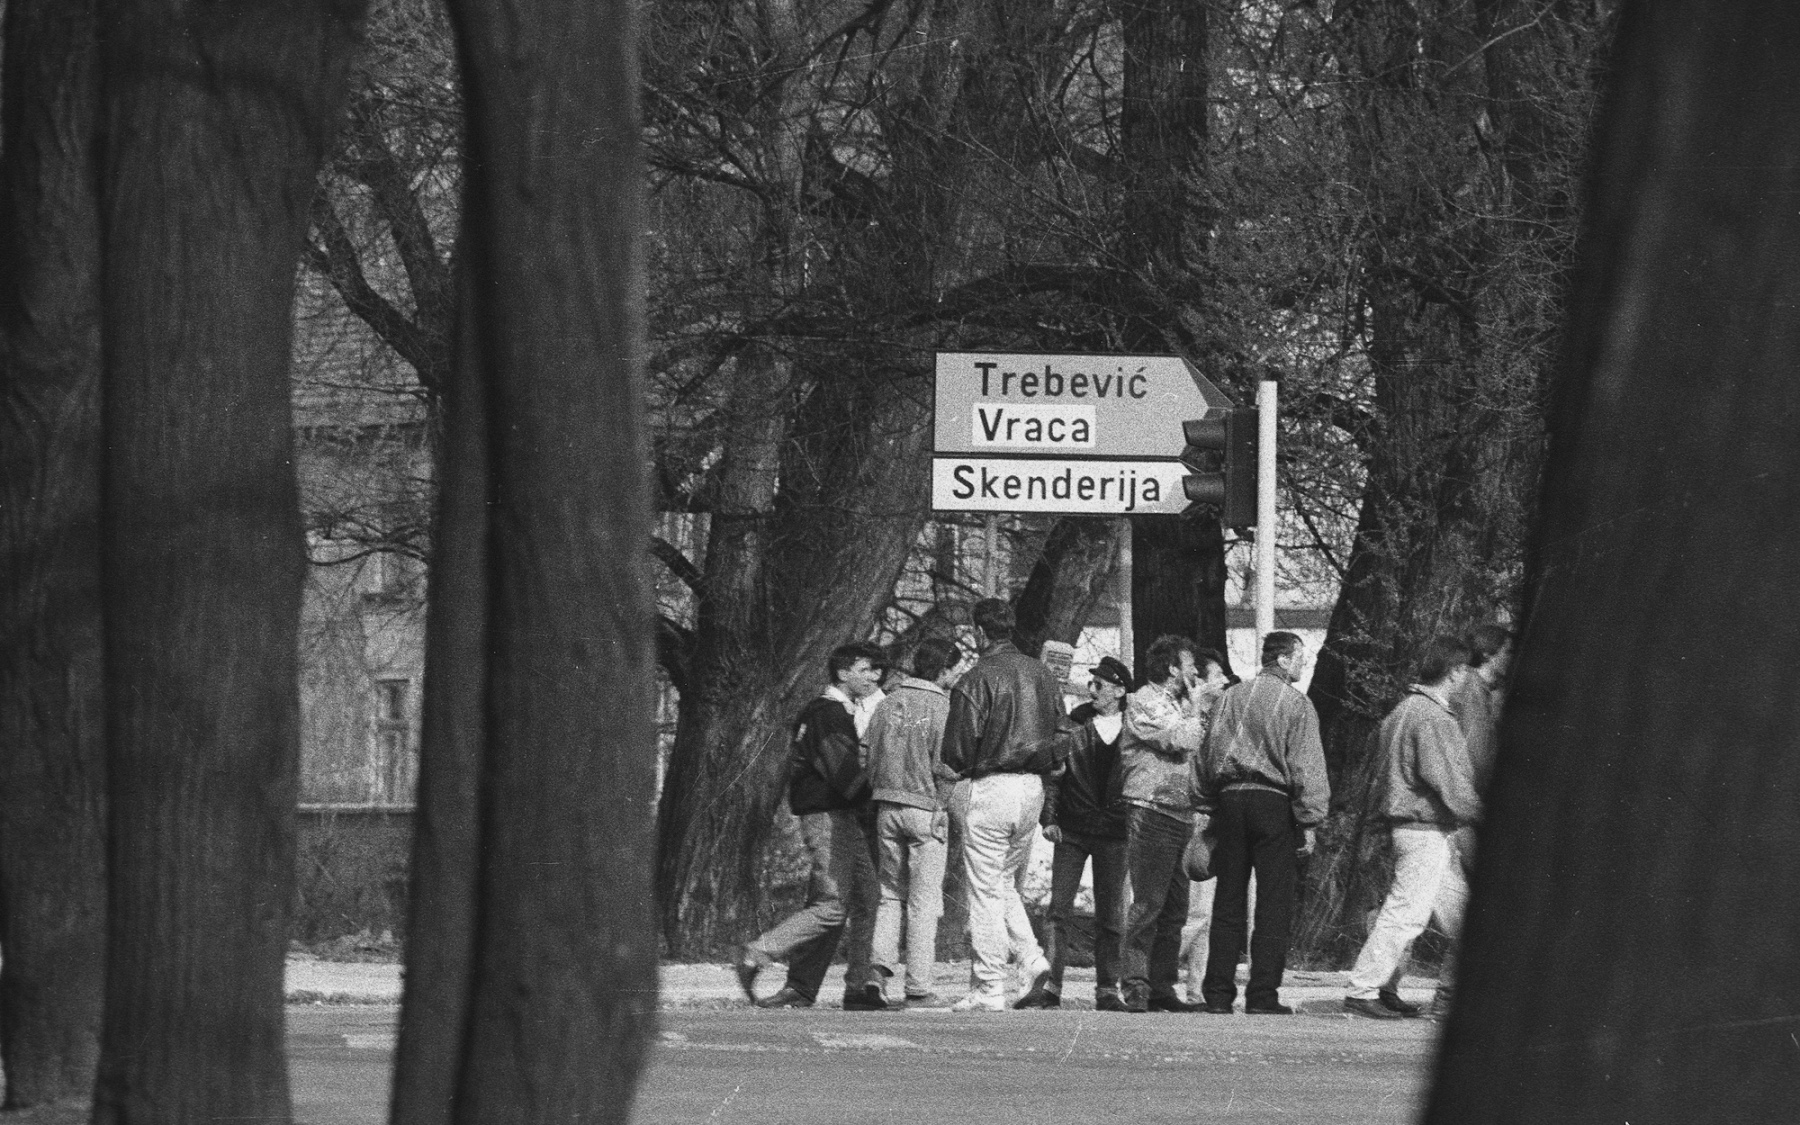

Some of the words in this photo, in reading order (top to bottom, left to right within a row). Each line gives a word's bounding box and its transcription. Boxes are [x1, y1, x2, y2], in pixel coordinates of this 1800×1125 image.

[974, 362, 1148, 399] Trebević
[978, 408, 1090, 442] Vraca
[952, 464, 1161, 511] Skenderija
